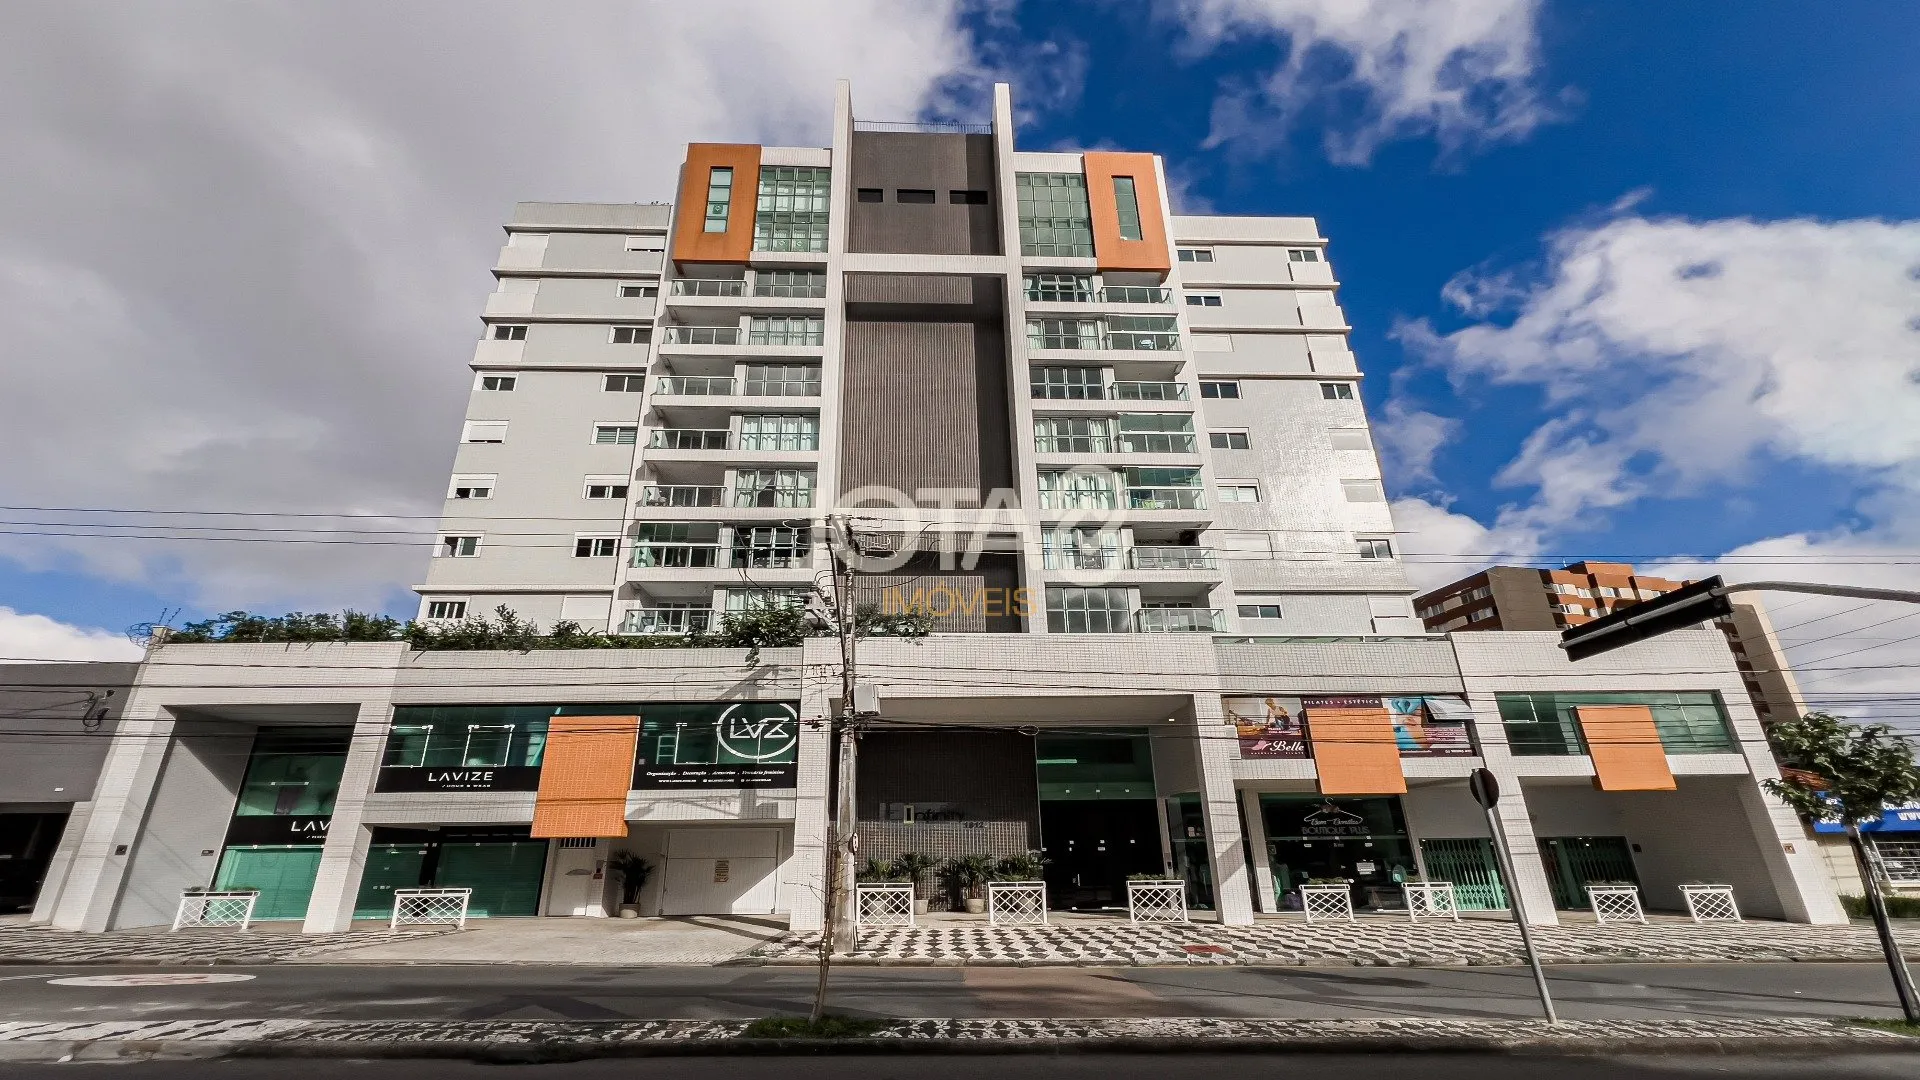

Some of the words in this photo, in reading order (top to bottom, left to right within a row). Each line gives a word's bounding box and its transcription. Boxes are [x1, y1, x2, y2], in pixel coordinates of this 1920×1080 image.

[1270, 740, 1305, 752] Belle
[428, 771, 494, 782] LAVIZE
[1302, 826, 1346, 835] BOUTIQUE
[1349, 826, 1371, 835] PLUS
